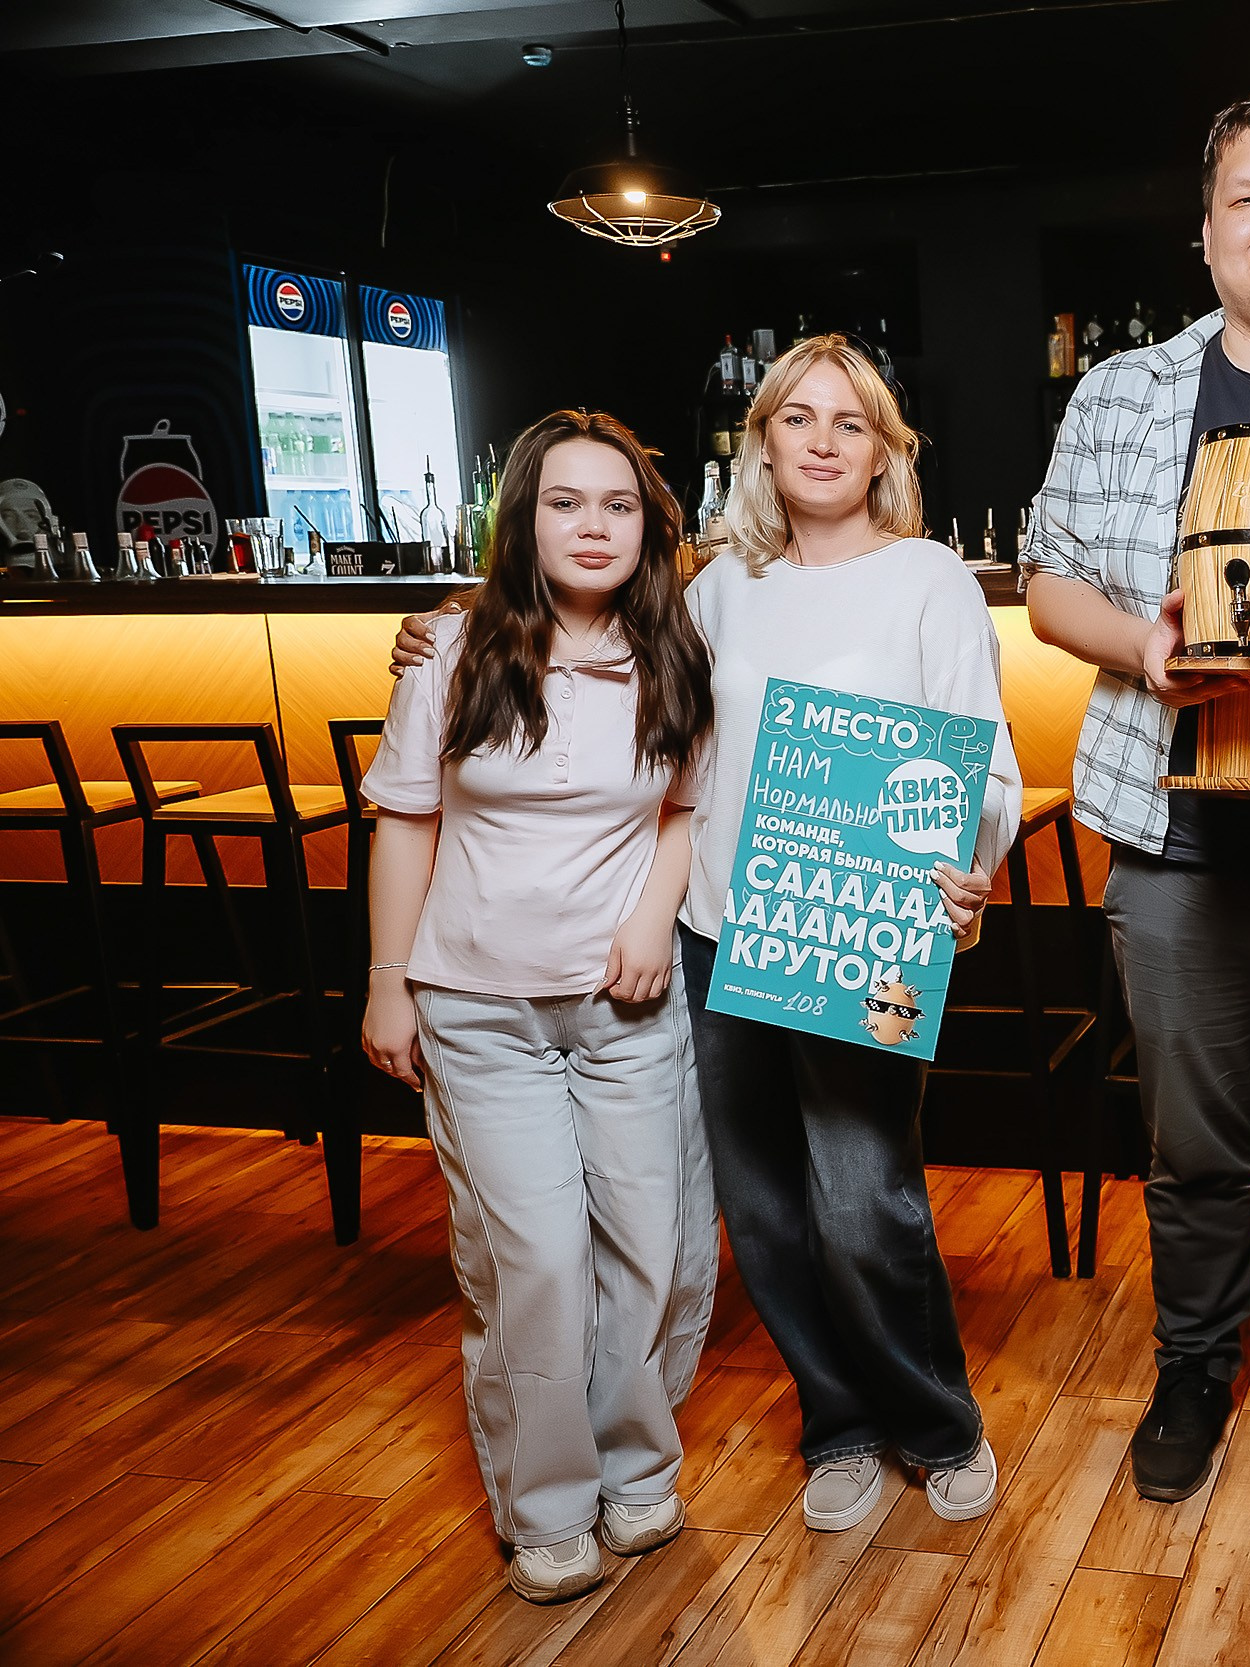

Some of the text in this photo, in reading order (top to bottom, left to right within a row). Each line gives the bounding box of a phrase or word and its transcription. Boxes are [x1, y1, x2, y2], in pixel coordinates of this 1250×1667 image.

[279, 297, 303, 307] PEPSI
[390, 315, 410, 325] PEPSI
[122, 509, 213, 536] PEPSI
[330, 554, 363, 565] MAKE IT
[331, 564, 364, 575] COUNT
[775, 697, 919, 750] 2 МЕСТО
[768, 741, 832, 785] НАМ
[755, 814, 845, 849] КОМАНДЕ,
[881, 803, 968, 834] ПЛИЗ!
[752, 833, 934, 885] КОТОРАЯ БЫЛА ПОЧТ
[782, 991, 828, 1016] 108
